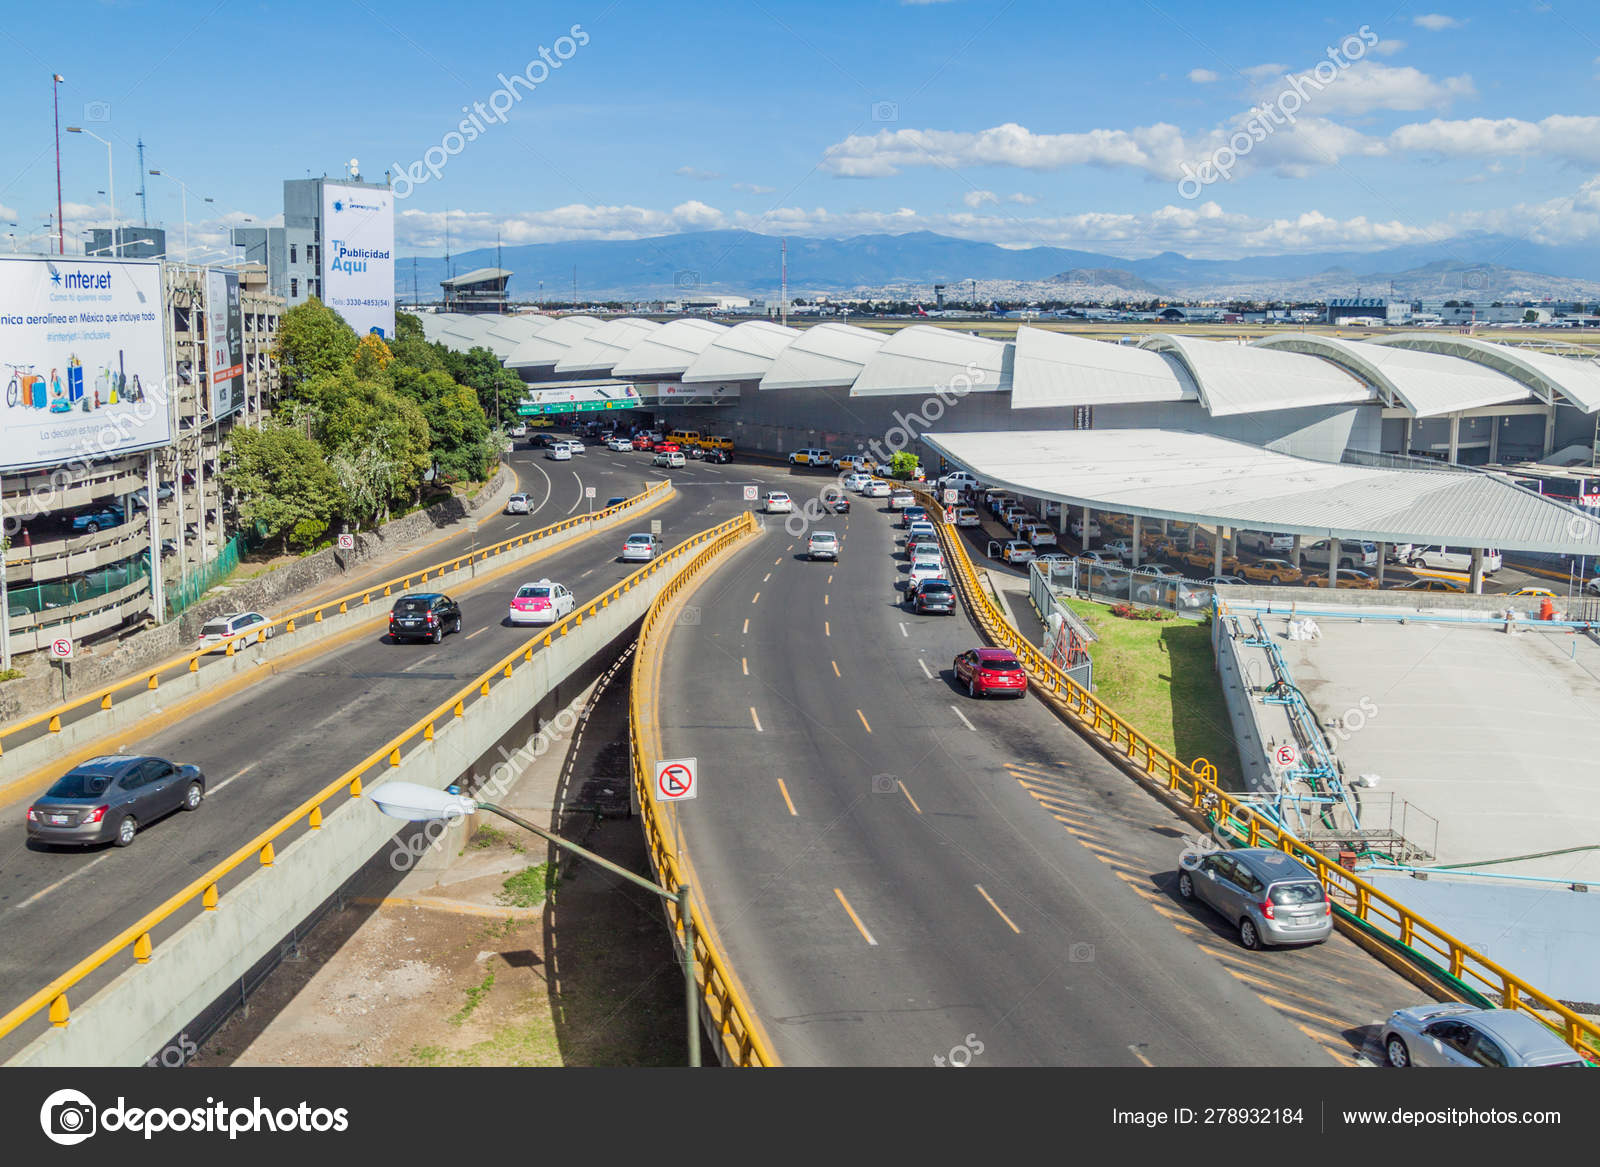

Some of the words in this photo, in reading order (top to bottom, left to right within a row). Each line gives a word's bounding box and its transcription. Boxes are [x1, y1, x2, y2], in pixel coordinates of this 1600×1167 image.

[340, 247, 390, 259] Publicidad
[331, 257, 367, 275] Aquí
[65, 270, 111, 289] interjet
[26, 312, 67, 325] aerolínea
[69, 314, 78, 324] en
[80, 311, 104, 323] México
[105, 314, 118, 325] que
[119, 312, 141, 324] incluye
[142, 312, 155, 321] todo
